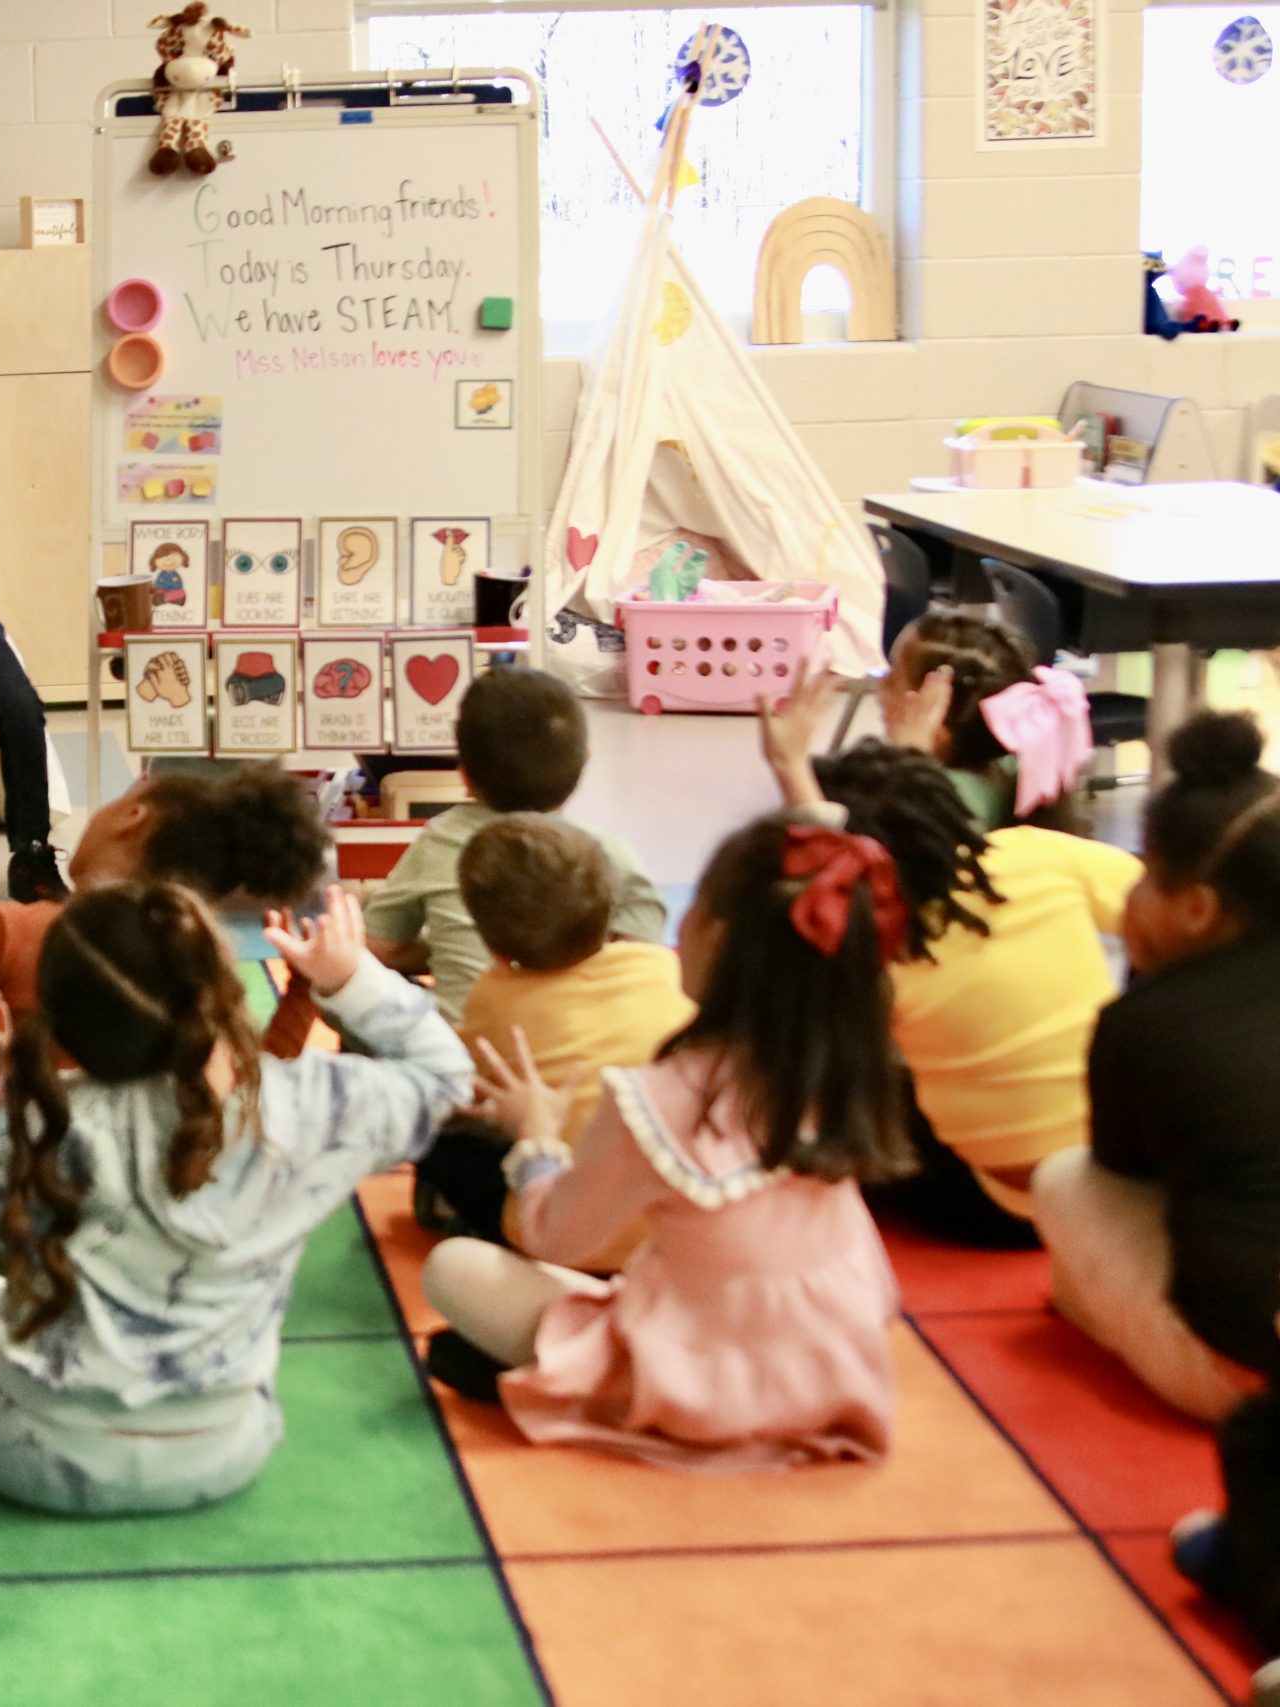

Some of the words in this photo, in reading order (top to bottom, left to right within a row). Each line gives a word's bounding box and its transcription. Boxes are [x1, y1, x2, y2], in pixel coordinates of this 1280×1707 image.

[193, 183, 274, 234] Good
[282, 188, 395, 238] Morning
[396, 179, 495, 218] friends!
[187, 238, 279, 295] Today
[289, 258, 309, 284] is
[320, 242, 472, 297] Thursday.
[183, 292, 252, 342] We
[262, 298, 320, 333] have
[337, 295, 461, 335] STEAM.
[235, 349, 284, 379] Miss
[292, 347, 365, 370] Nelson
[372, 342, 419, 367] loves
[135, 526, 174, 539] WHOLE
[152, 609, 193, 622] TENING
